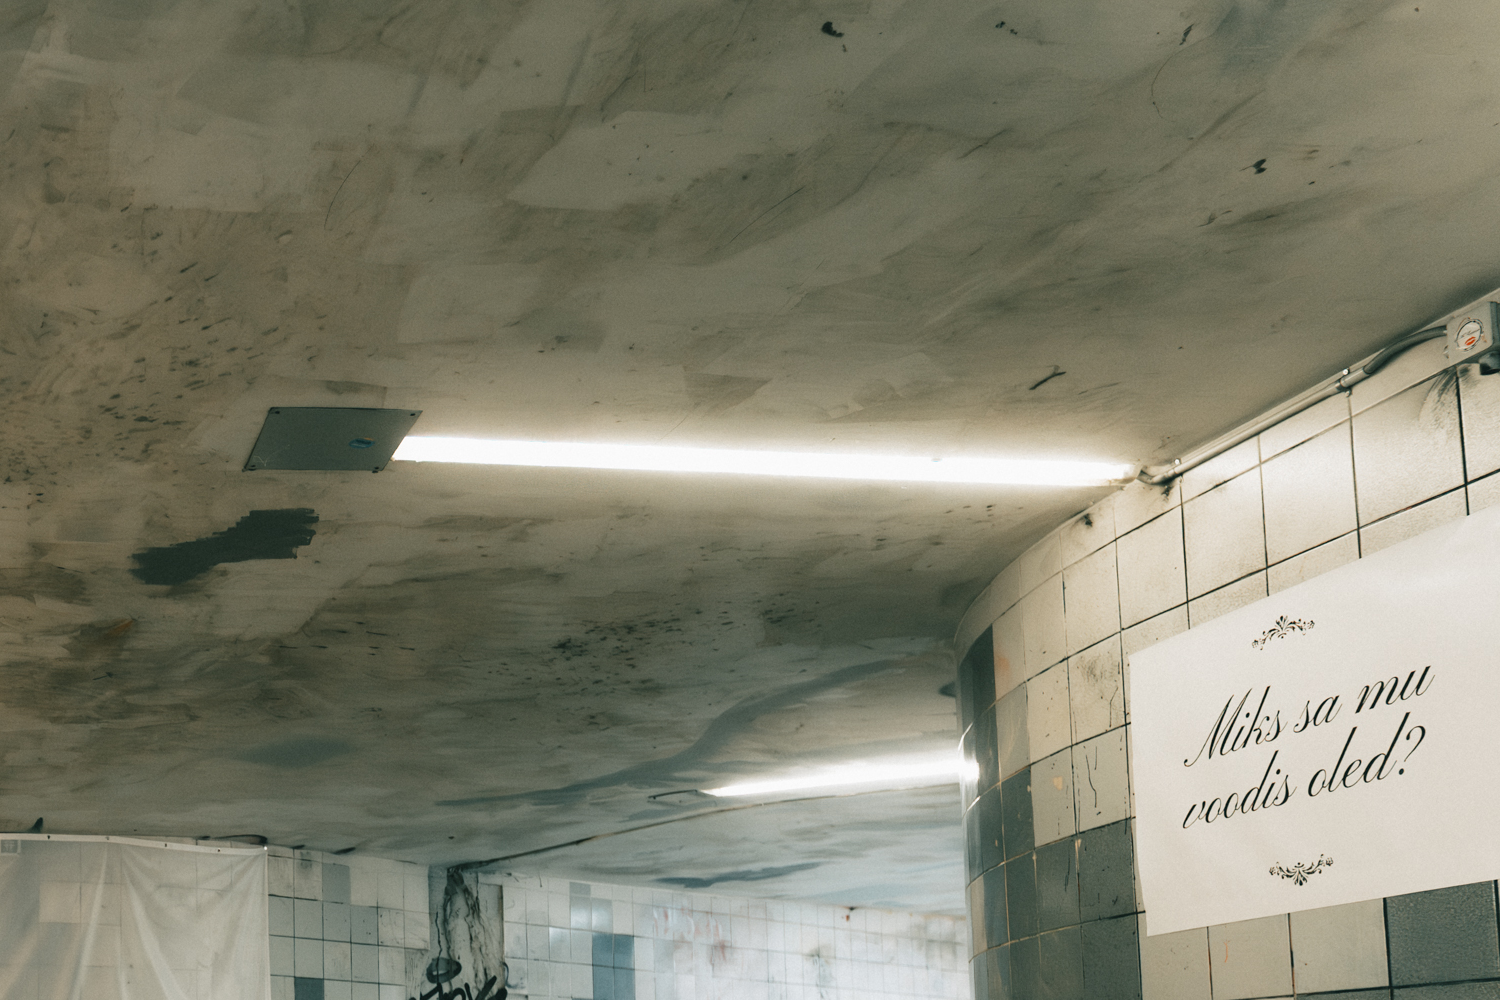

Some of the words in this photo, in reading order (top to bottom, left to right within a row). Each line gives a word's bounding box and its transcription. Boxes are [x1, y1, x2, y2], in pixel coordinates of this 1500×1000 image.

[1182, 750, 1298, 829] voodis
[1307, 712, 1427, 798] oled?
[1183, 685, 1287, 768] Miks
[1293, 693, 1343, 734] sa
[1355, 665, 1435, 714] mu
